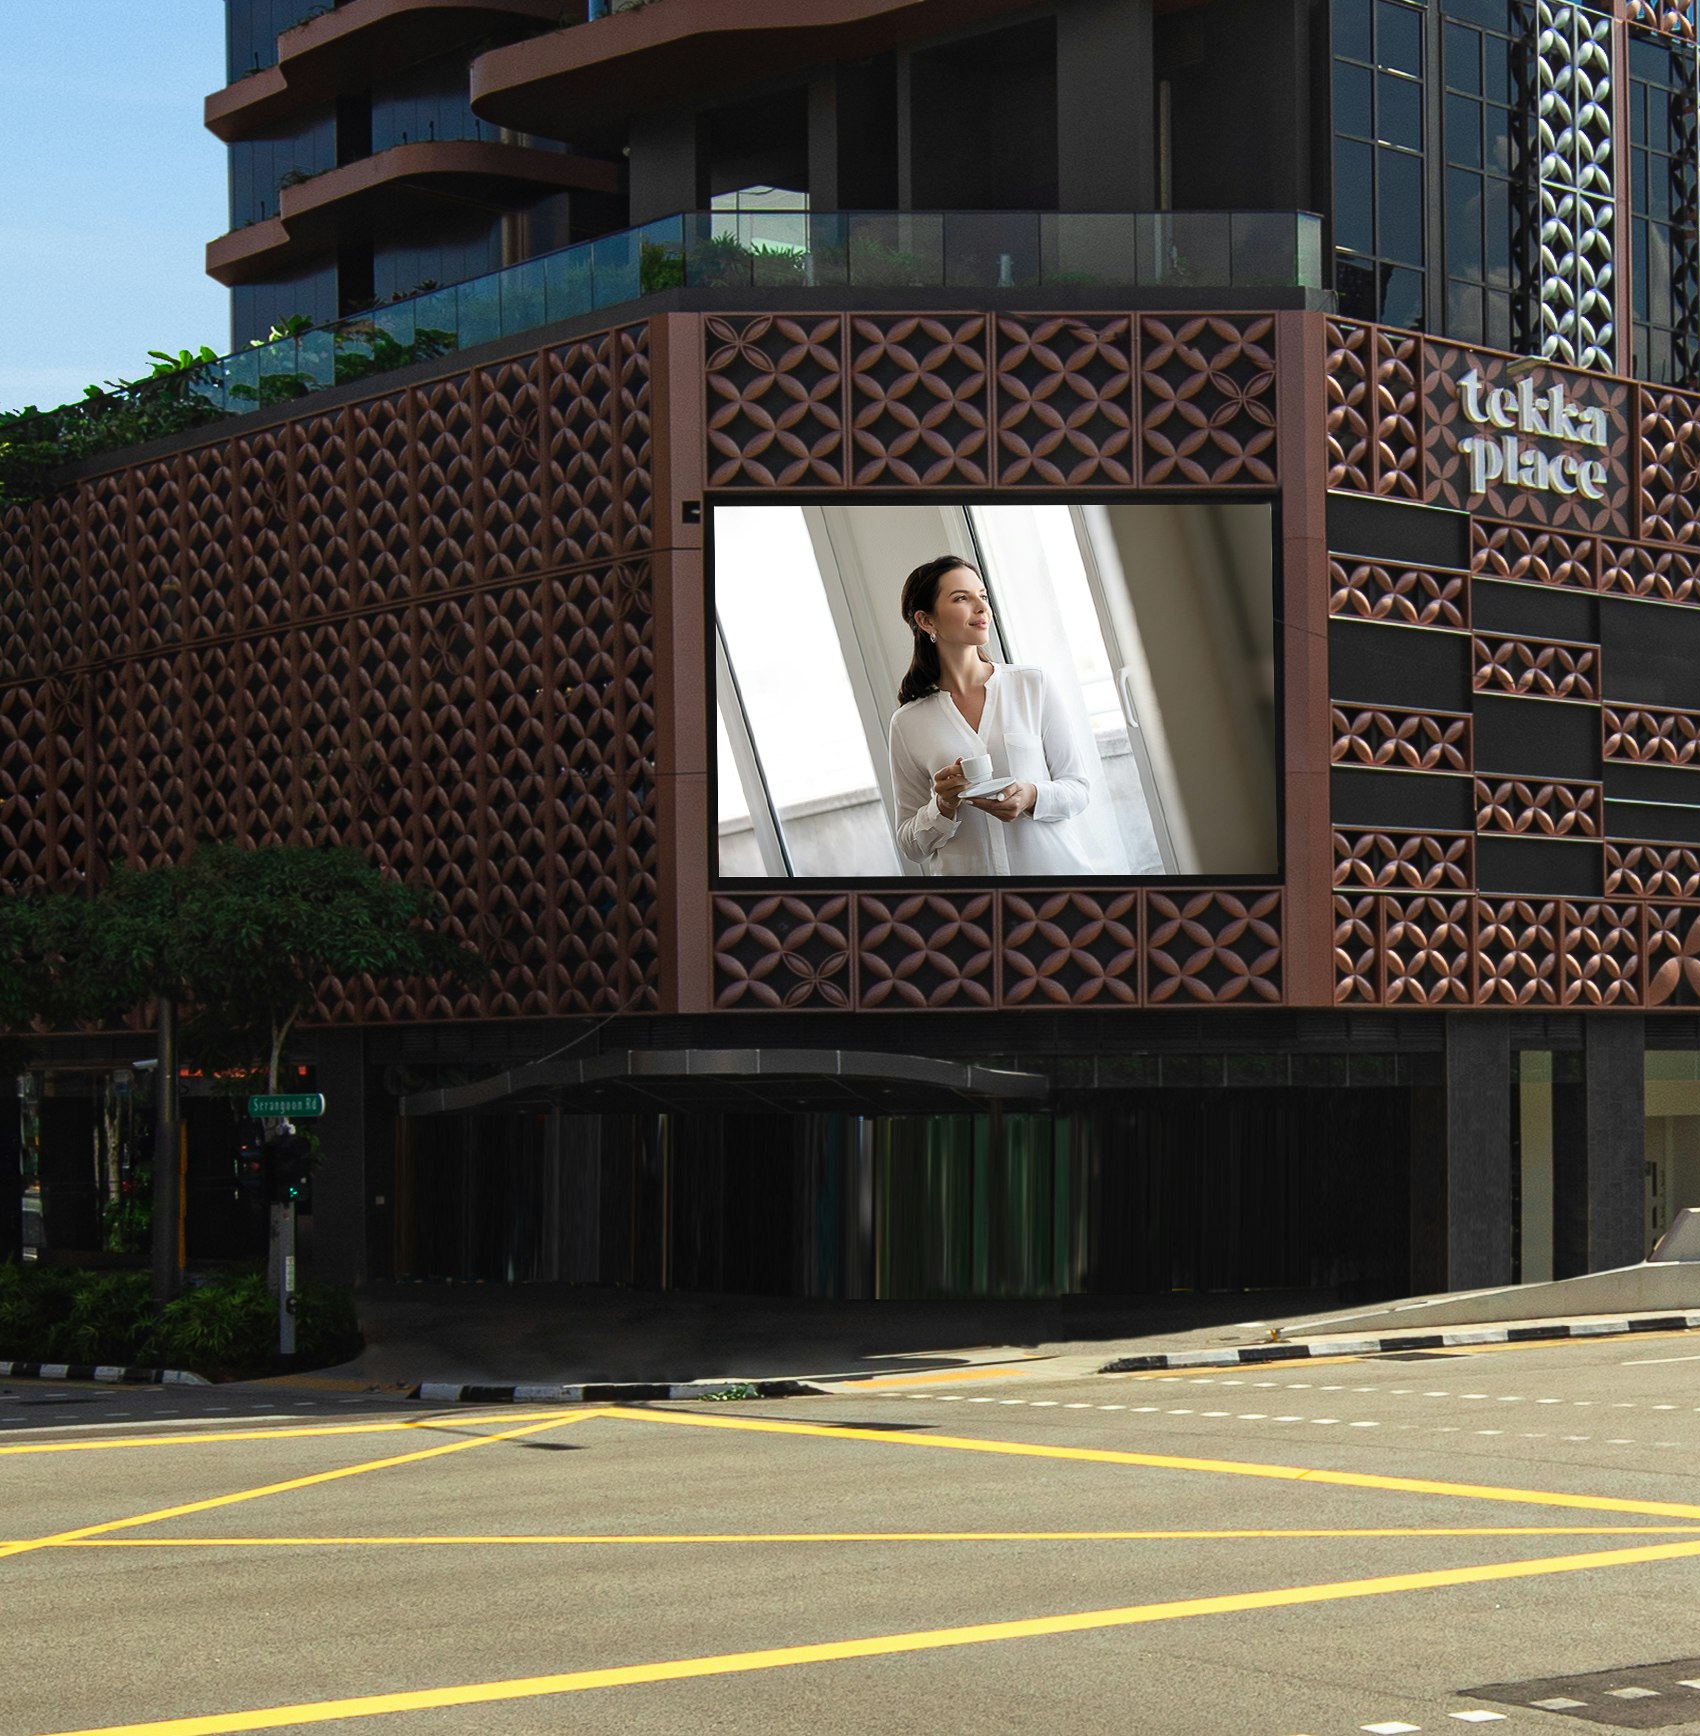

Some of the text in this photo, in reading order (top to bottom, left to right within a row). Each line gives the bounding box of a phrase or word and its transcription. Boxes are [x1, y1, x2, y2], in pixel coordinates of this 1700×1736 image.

[1457, 369, 1608, 447] tekka
[1457, 435, 1608, 500] place
[253, 1097, 318, 1114] Serangoon Rd
